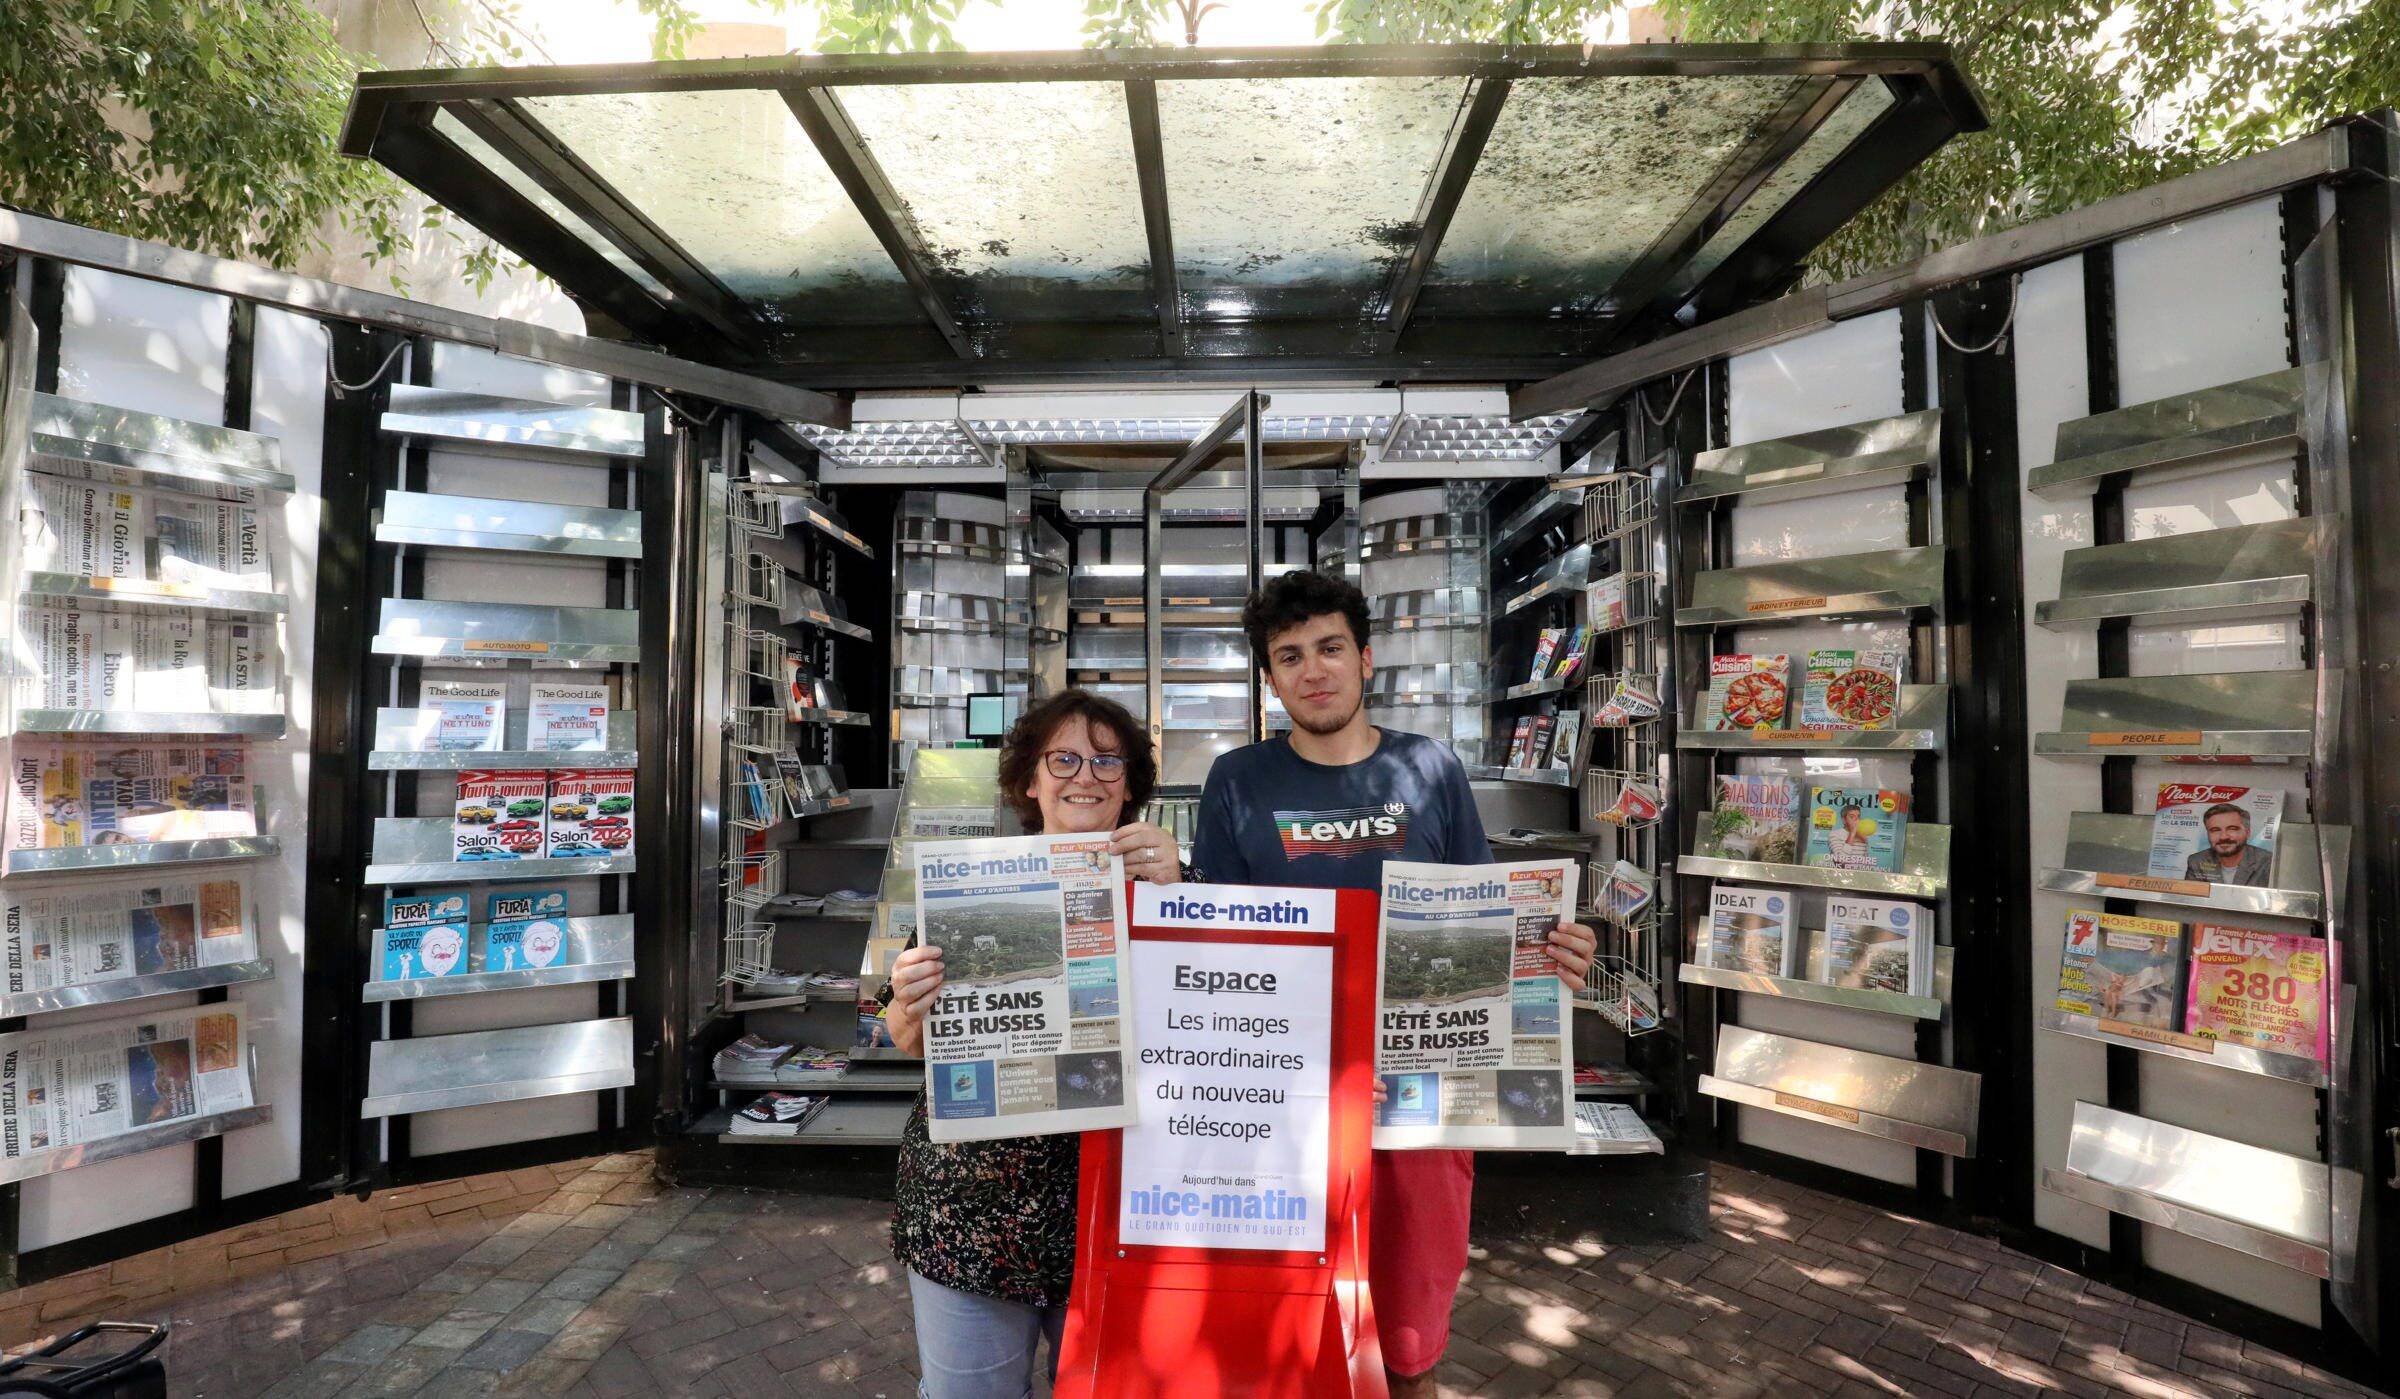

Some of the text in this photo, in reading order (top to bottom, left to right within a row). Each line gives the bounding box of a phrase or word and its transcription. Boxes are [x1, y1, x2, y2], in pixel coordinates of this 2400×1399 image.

[1712, 661, 1751, 673] Cuisine
[1808, 656, 1853, 668] Cuisine
[104, 652, 122, 696] Libero
[428, 687, 500, 697] The Good Life
[536, 689, 603, 699] The Good Life
[2121, 734, 2165, 744] PEOPLE
[117, 778, 133, 810] JOYA
[1724, 783, 1790, 805] MAISONS
[2164, 785, 2198, 800] Nous
[90, 779, 116, 829] INTER
[457, 831, 543, 847] Salon 2023
[551, 828, 632, 843] Salon 2023
[1053, 844, 1076, 852] Azur
[922, 852, 1048, 879] nice-matin
[1823, 853, 1878, 865] ON RESPIRE
[1534, 870, 1560, 879] Viager
[1388, 880, 1506, 902] nice-matin
[1715, 894, 1757, 908] IDEAT
[394, 904, 428, 919] FURIA
[498, 900, 530, 914] FURIA
[1159, 895, 1309, 924] nice-matin
[1832, 905, 1879, 921] IDEAT
[8, 905, 20, 932] SERA
[2193, 927, 2276, 960] Jeux
[2216, 927, 2277, 942] Femme Actuelle
[8, 933, 22, 970] DELLA
[1174, 965, 1277, 994] Espace
[2222, 969, 2296, 1005] 380
[985, 991, 1043, 1011] SANS
[2217, 995, 2299, 1017] MOTS FLÉCHÉS
[931, 1013, 1046, 1038] LES RUSSES
[1167, 1008, 1289, 1038] Les images
[1383, 1009, 1489, 1029] L'ÉTÉ SANS
[968, 1043, 1001, 1051] beaucoup
[1027, 1046, 1058, 1054] compter
[1030, 1039, 1062, 1047] dépenser
[1383, 1030, 1489, 1050] LES RUSSES
[3, 1050, 18, 1079] SERA
[1140, 1046, 1304, 1070] extraordinaires
[4, 1081, 18, 1116] DELLA
[1156, 1080, 1285, 1104] du nouveau
[1168, 1115, 1271, 1143] téléscope
[1182, 1174, 1256, 1187] Aujourd'hui dans
[1130, 1185, 1307, 1221] nice-matin
[1129, 1221, 1140, 1229] LE
[1145, 1222, 1179, 1231] GRAND
[1185, 1222, 1239, 1233] QUOTIDIEN
[1245, 1224, 1257, 1233] DU
